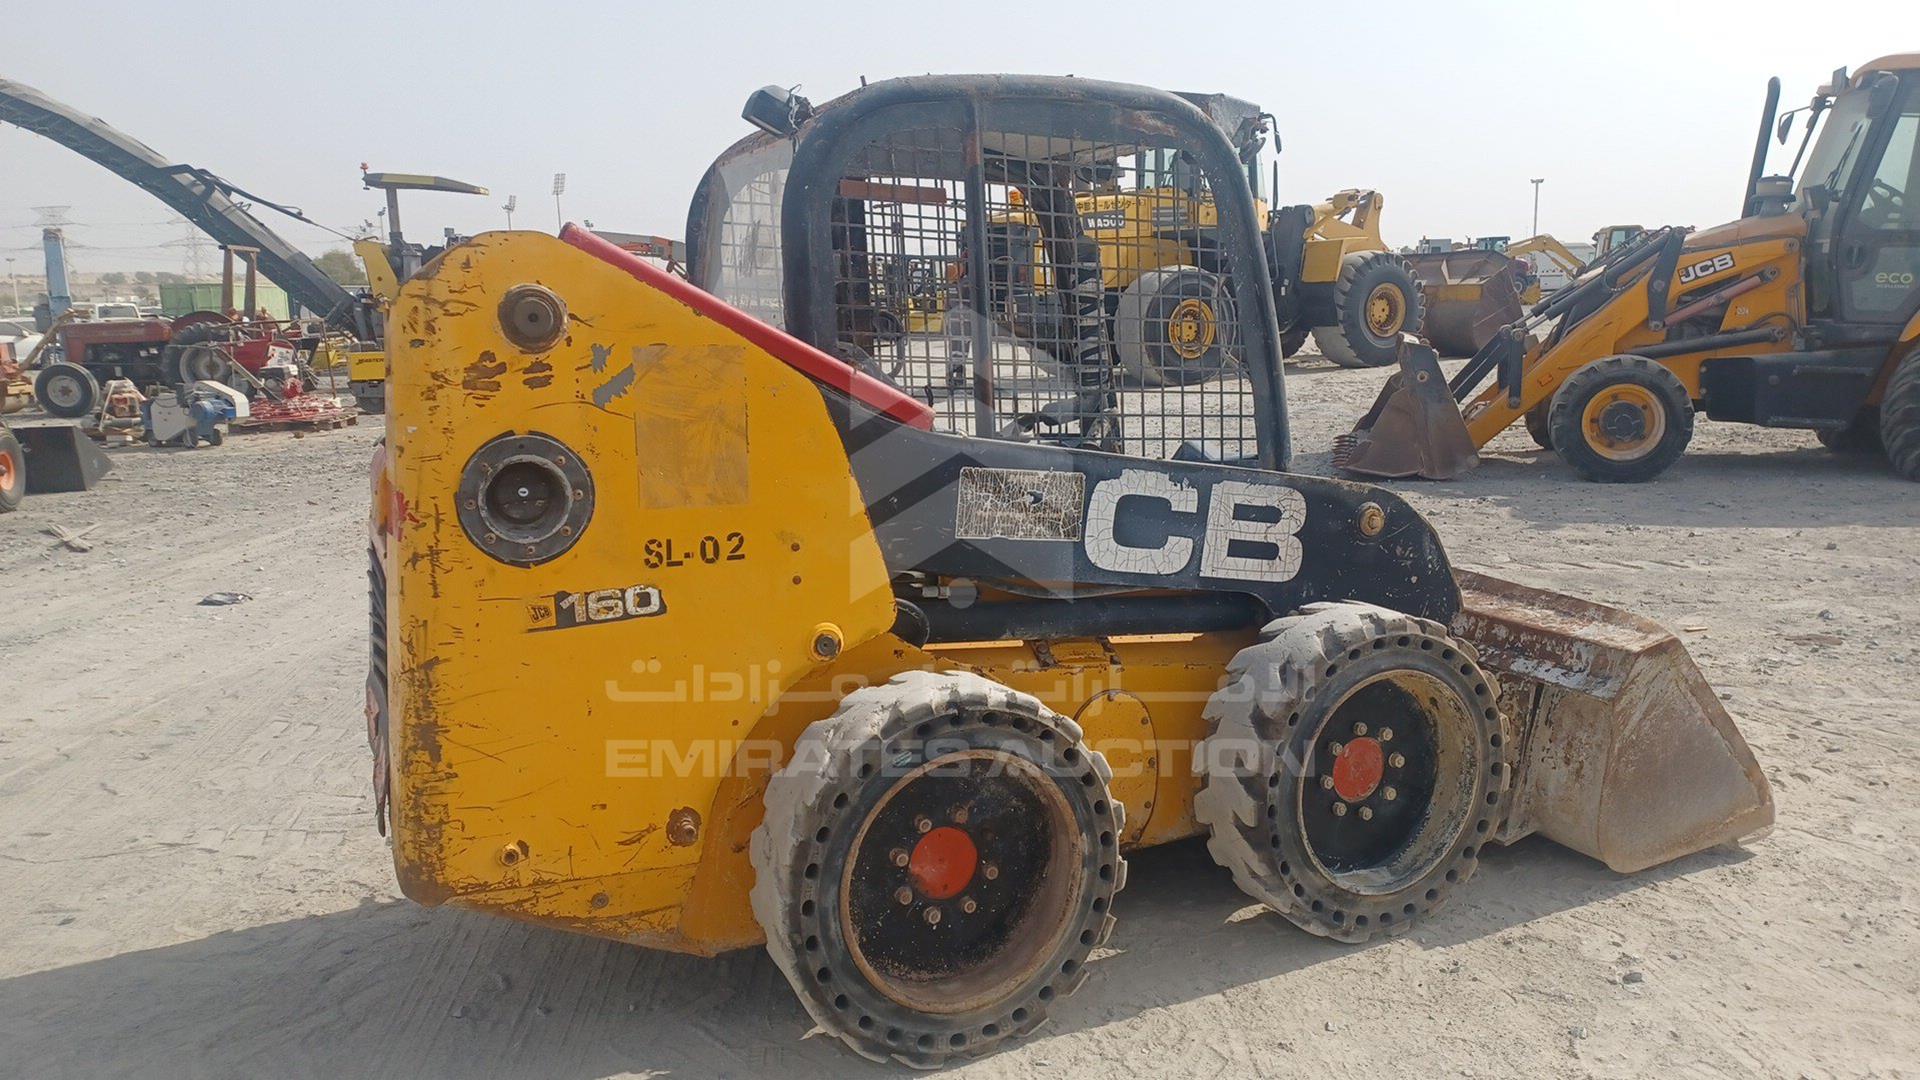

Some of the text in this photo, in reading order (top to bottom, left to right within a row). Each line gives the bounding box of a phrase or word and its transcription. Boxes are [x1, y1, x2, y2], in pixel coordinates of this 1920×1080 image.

[1087, 215, 1124, 228] WA500
[1679, 253, 1734, 283] JCB
[1875, 272, 1913, 284] eco
[643, 531, 746, 569] SL-02
[531, 604, 552, 622] JCB
[560, 584, 661, 623] 160
